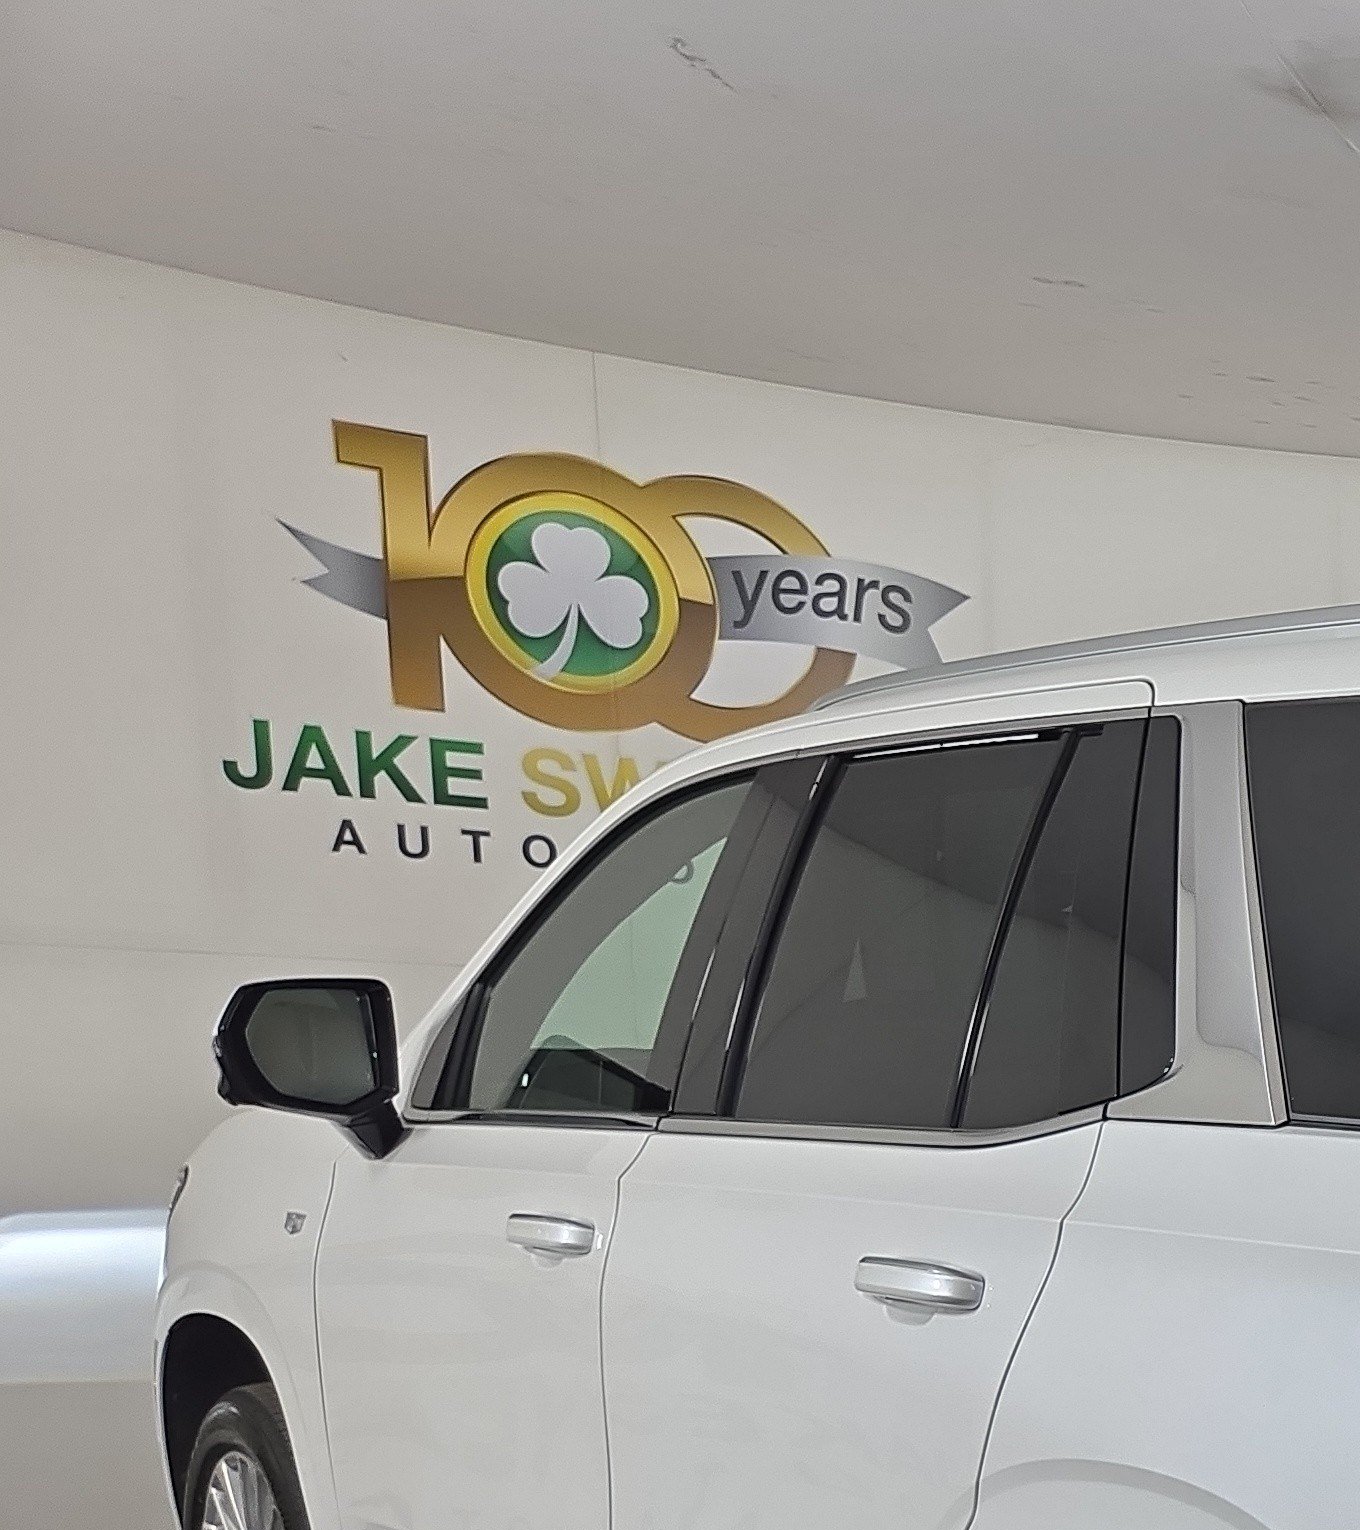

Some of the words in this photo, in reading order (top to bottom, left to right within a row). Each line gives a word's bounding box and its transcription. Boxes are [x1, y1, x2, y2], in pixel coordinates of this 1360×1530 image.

[729, 568, 914, 635] years
[221, 718, 490, 810] JAKE
[331, 818, 558, 869] AUTO
